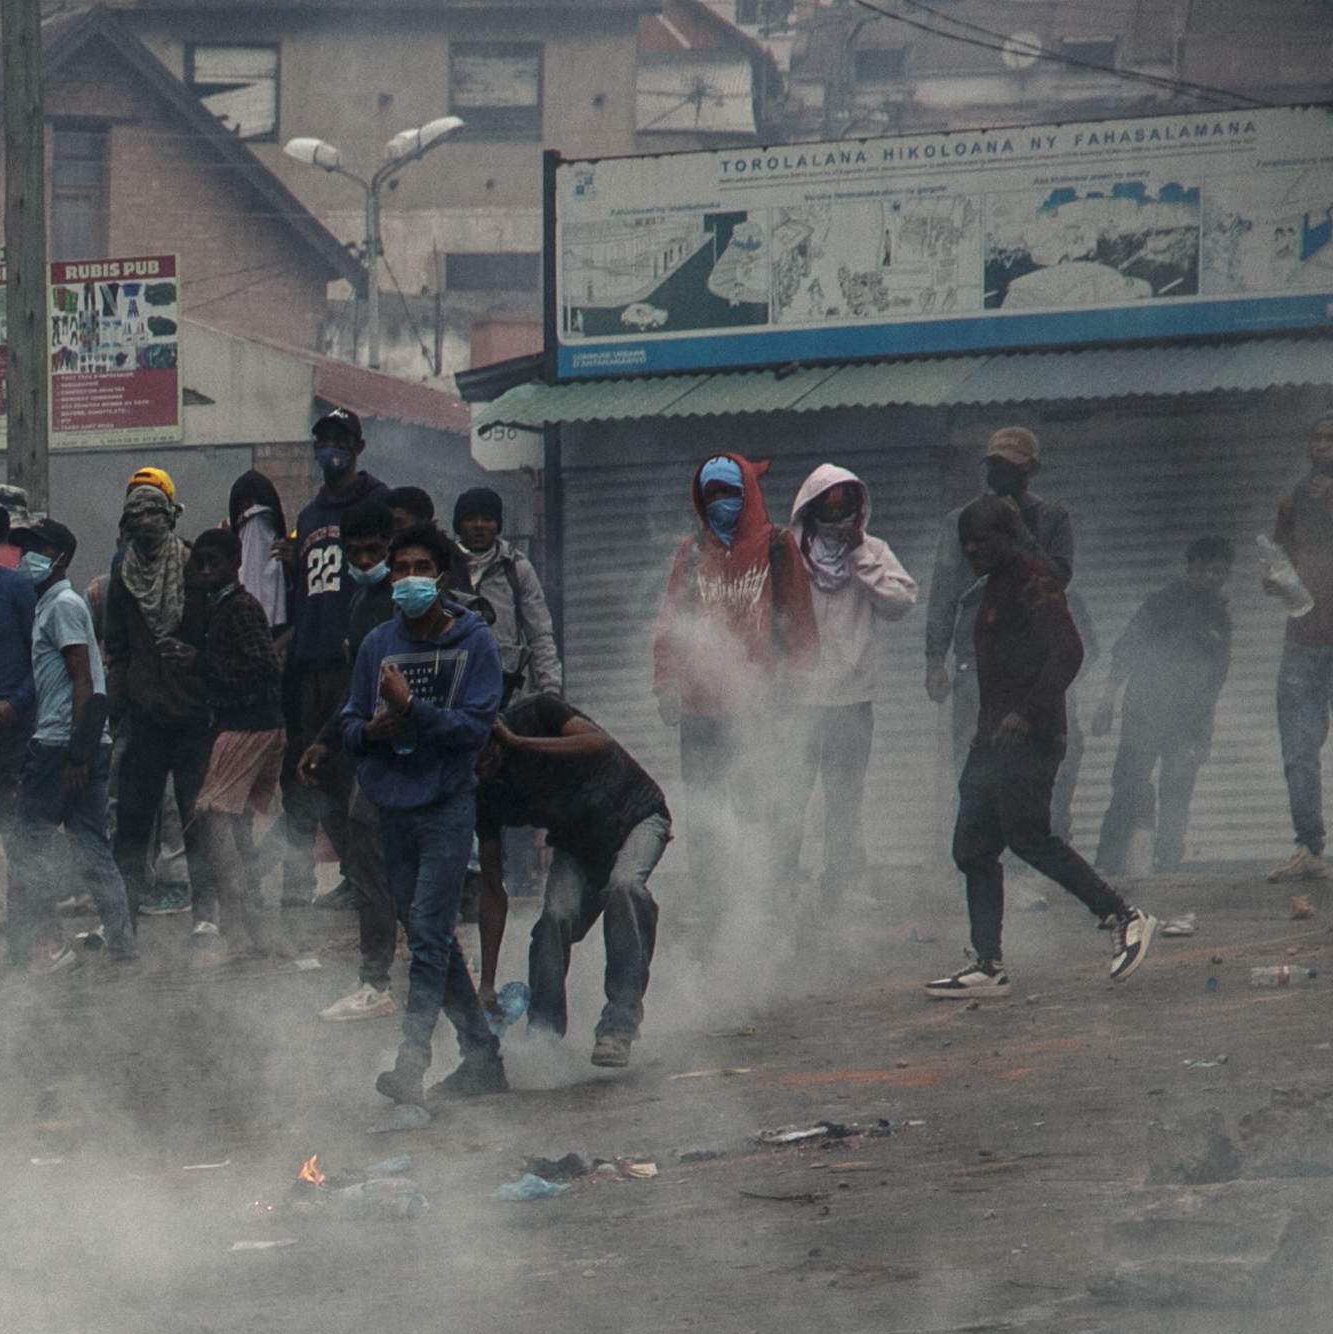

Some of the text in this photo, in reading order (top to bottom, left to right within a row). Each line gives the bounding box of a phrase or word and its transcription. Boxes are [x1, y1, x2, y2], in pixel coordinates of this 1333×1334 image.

[721, 150, 867, 174] TOROLALANA
[883, 139, 1014, 162] HIKOLOANA
[1030, 134, 1058, 150] NY
[1074, 120, 1257, 147] FAHASALAMANA
[65, 260, 160, 281] RUBIS PUB
[307, 544, 342, 597] 22
